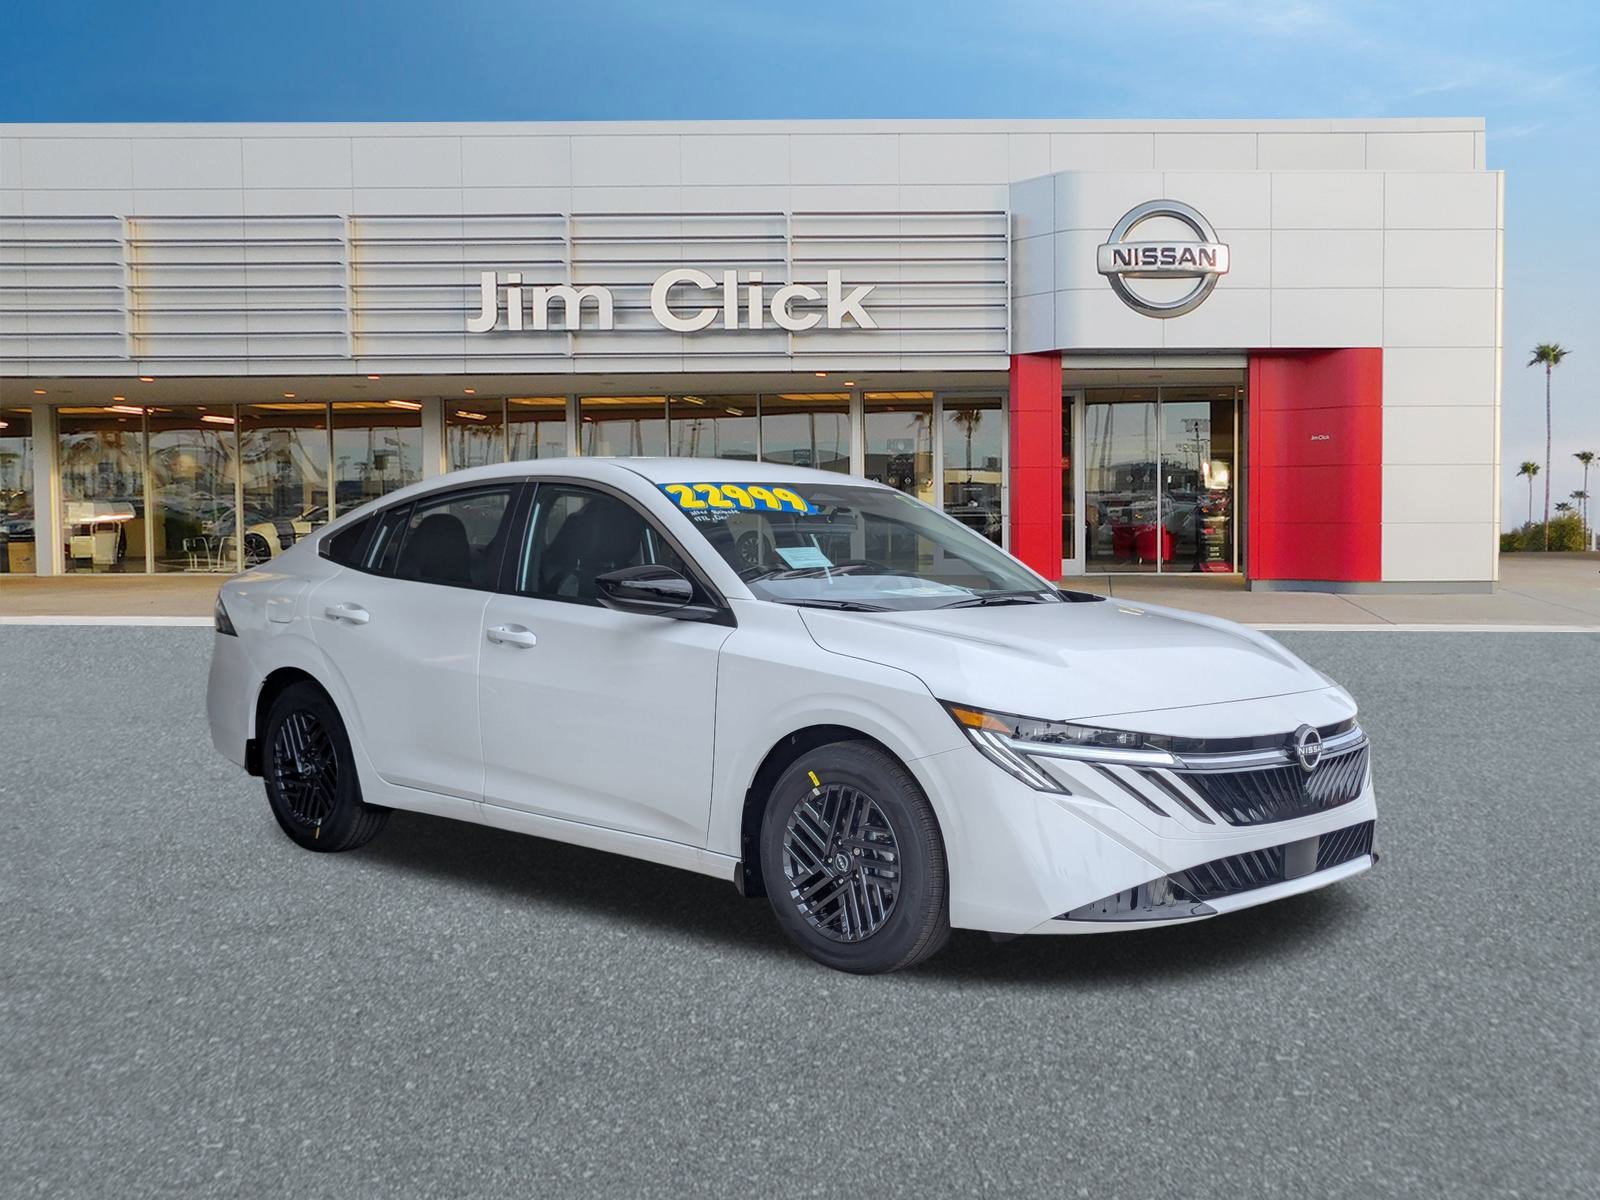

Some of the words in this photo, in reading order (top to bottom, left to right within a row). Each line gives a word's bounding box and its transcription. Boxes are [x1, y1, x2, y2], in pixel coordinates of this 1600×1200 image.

[1112, 247, 1217, 266] NISSAN
[466, 271, 613, 332] Jim
[650, 267, 878, 333] Click
[664, 483, 808, 512] 22999
[1298, 745, 1322, 755] NISSA
